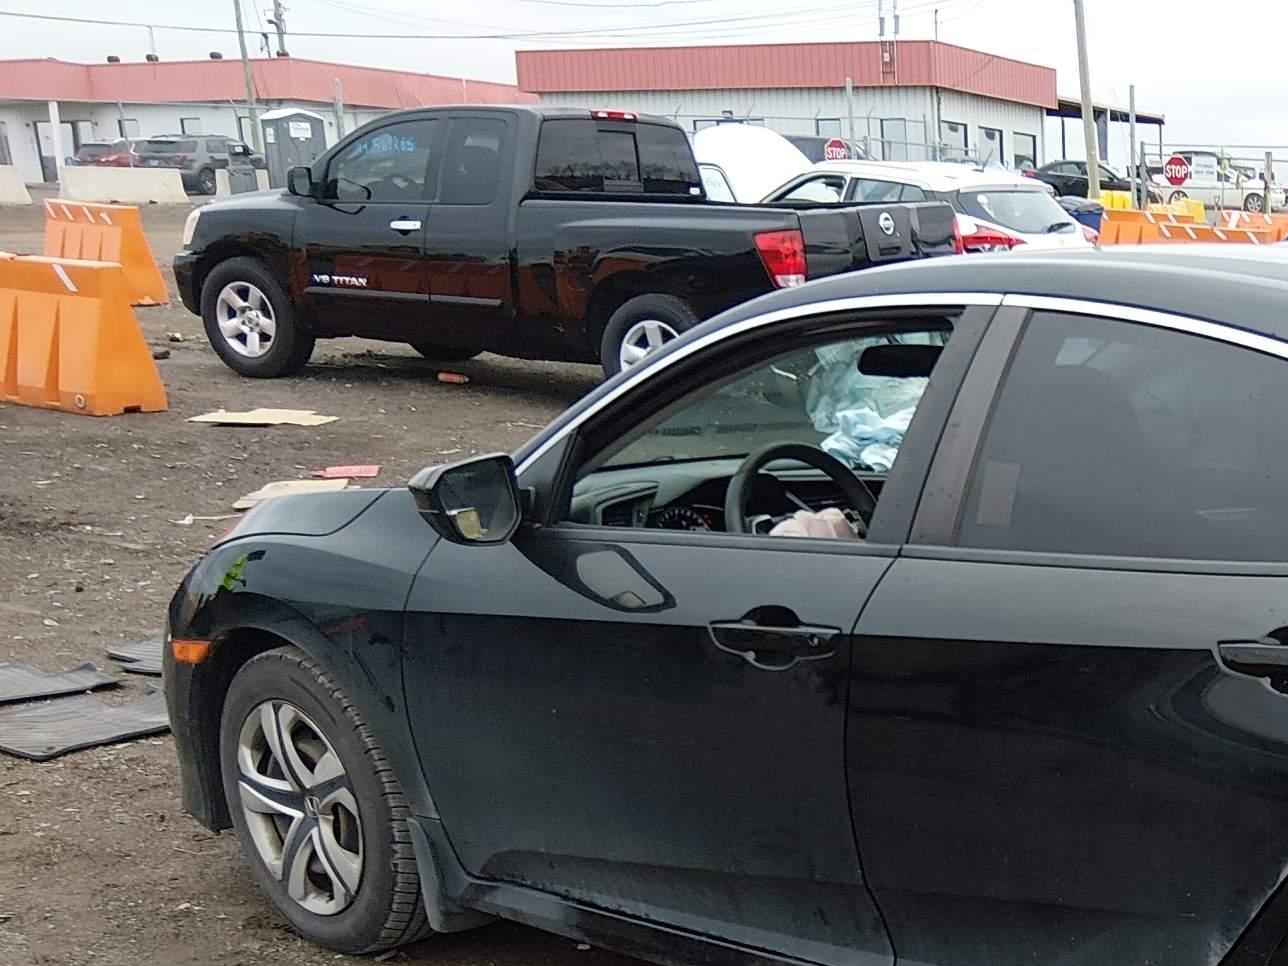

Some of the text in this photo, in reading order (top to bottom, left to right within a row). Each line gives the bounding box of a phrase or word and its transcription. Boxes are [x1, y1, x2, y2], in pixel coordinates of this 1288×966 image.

[827, 147, 848, 160] STOP
[1166, 165, 1188, 179] STOP
[313, 274, 368, 287] V8 TITAN
